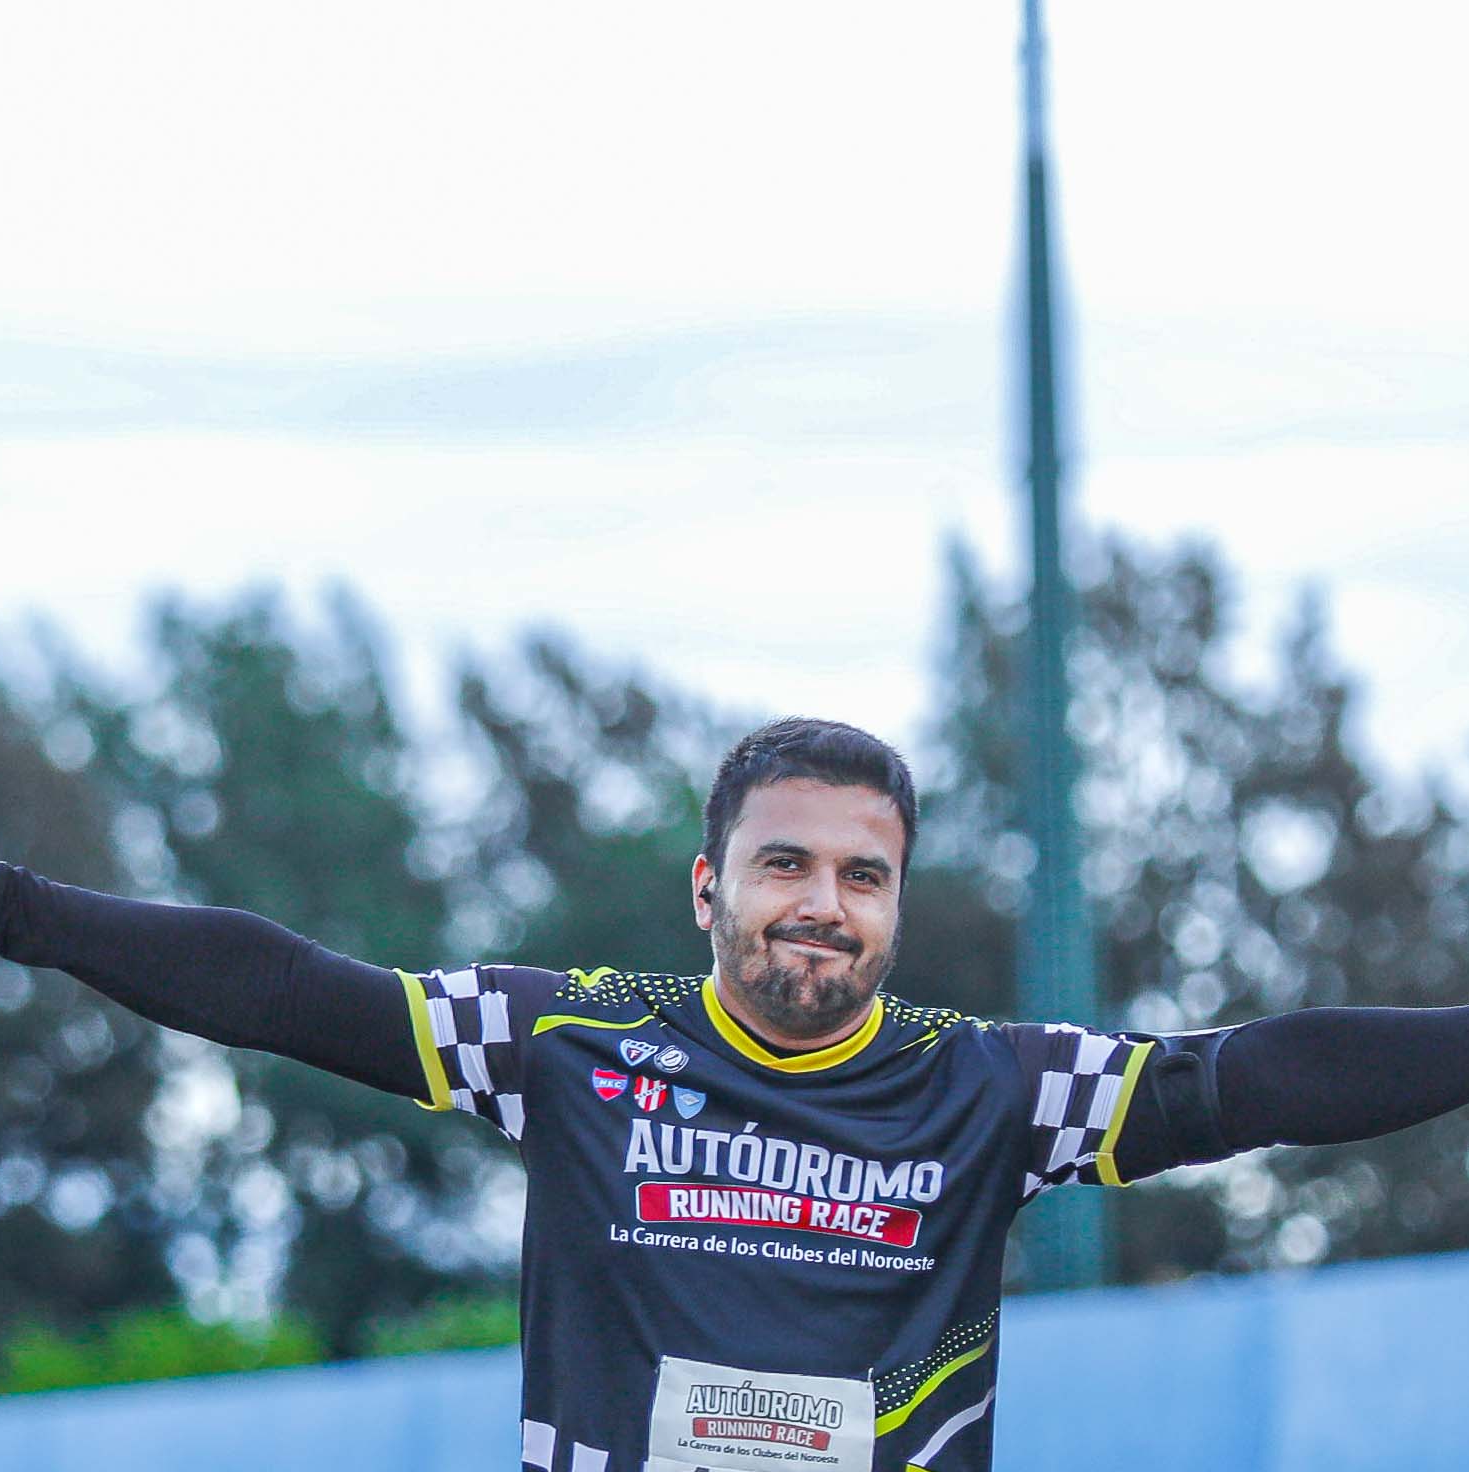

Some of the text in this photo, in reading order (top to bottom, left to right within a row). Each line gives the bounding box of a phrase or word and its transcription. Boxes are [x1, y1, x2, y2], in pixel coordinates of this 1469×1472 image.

[623, 1117, 945, 1204] AUTÓDROMO
[668, 1188, 892, 1239] RUNNING RACE
[610, 1223, 936, 1272] La Carrera de los Clubes del Noroeste
[686, 1380, 843, 1429] AUTÓDROMO
[677, 1438, 840, 1465] La Carrera de los Clubes del Noroeste
[707, 1420, 816, 1447] RUNNING RACE
